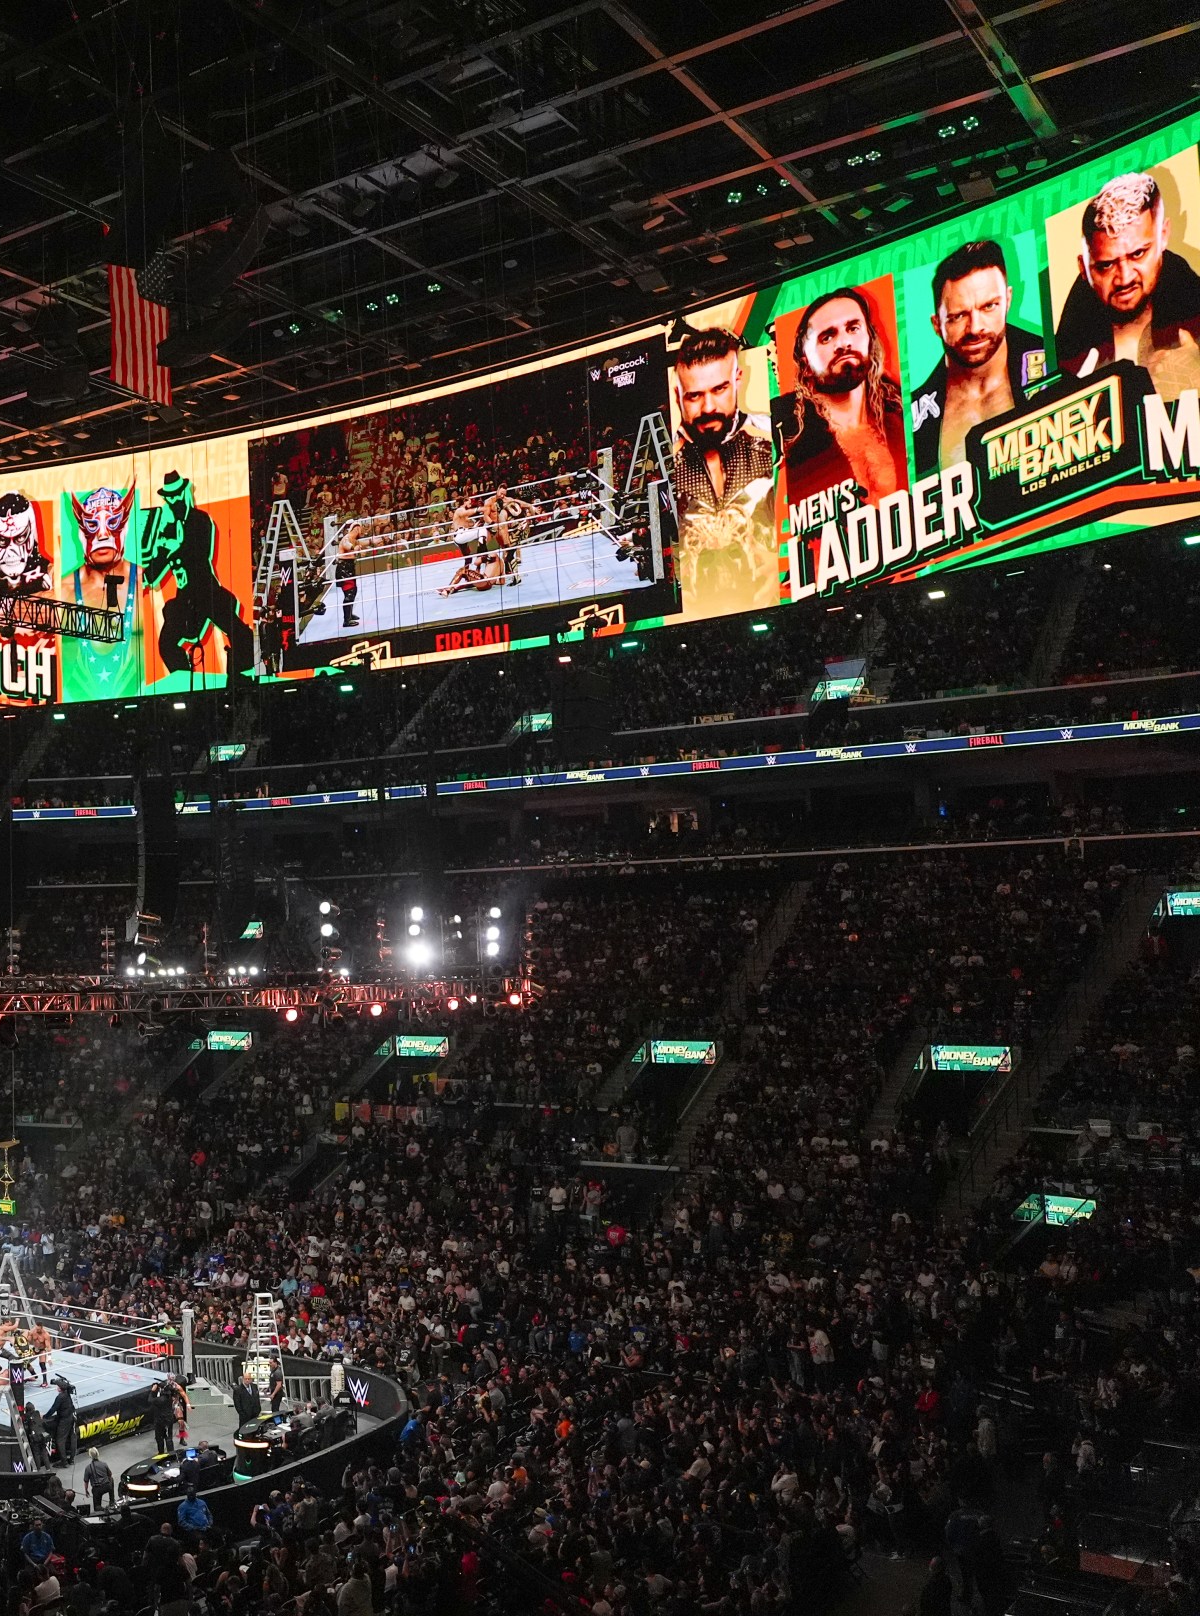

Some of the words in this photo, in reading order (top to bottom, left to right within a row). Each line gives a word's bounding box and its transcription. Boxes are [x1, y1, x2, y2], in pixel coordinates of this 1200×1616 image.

[608, 356, 645, 377] peacock
[988, 393, 1102, 470] MONEY
[1020, 418, 1113, 485] BANK
[1021, 480, 1047, 496] LOS
[1051, 451, 1111, 484] ANGELES
[789, 478, 855, 536] MEN'S
[788, 461, 977, 603] LADDER
[463, 781, 487, 790] FIREBALL
[566, 771, 589, 780] MONEY
[587, 773, 605, 781] BANK
[692, 760, 720, 771] FIREBALL
[816, 749, 843, 758] MONEY
[840, 751, 862, 759] BANK
[969, 736, 1003, 747] FIREBALL
[1123, 720, 1157, 731] MONEY
[1154, 722, 1179, 732] BANK
[402, 1040, 427, 1048] MONEY
[657, 1045, 688, 1054] MONEY
[938, 1051, 977, 1060] MONEY
[973, 1057, 1003, 1066] BANK
[79, 1413, 120, 1440] MONEY
[109, 1414, 145, 1435] BANK
